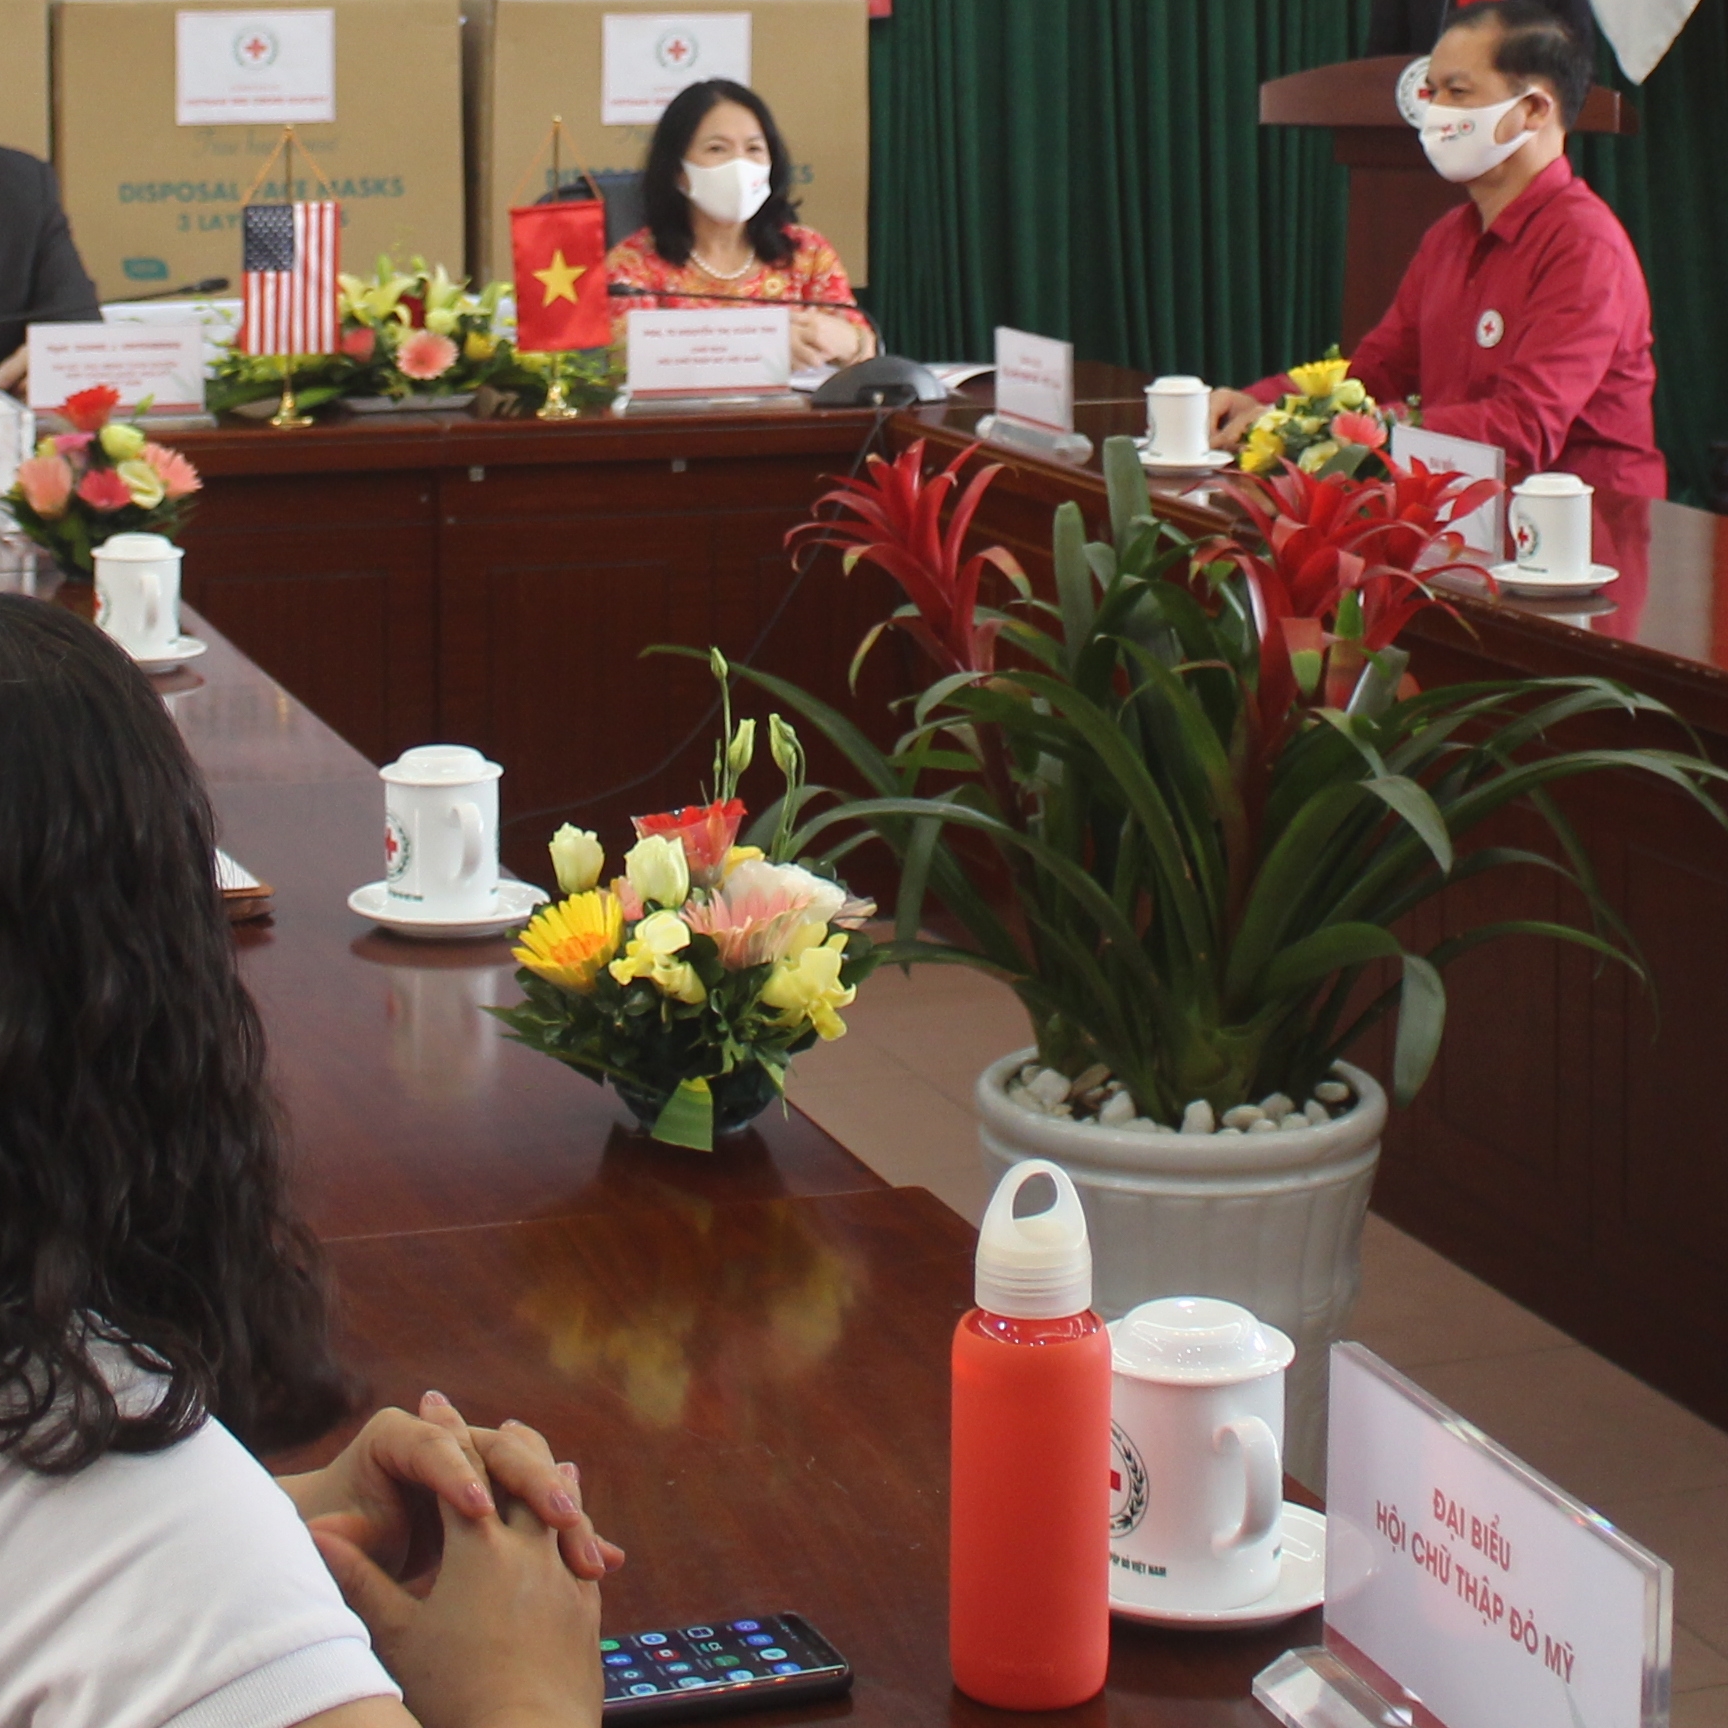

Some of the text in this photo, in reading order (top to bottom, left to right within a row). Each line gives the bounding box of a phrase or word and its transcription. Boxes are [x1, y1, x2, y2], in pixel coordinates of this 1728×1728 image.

[316, 176, 405, 199] MASKS
[1433, 1487, 1511, 1571] ĐẠI BIỂU
[1376, 1499, 1575, 1684] HỘI CHỮ THẬP ĐỎ MỸ
